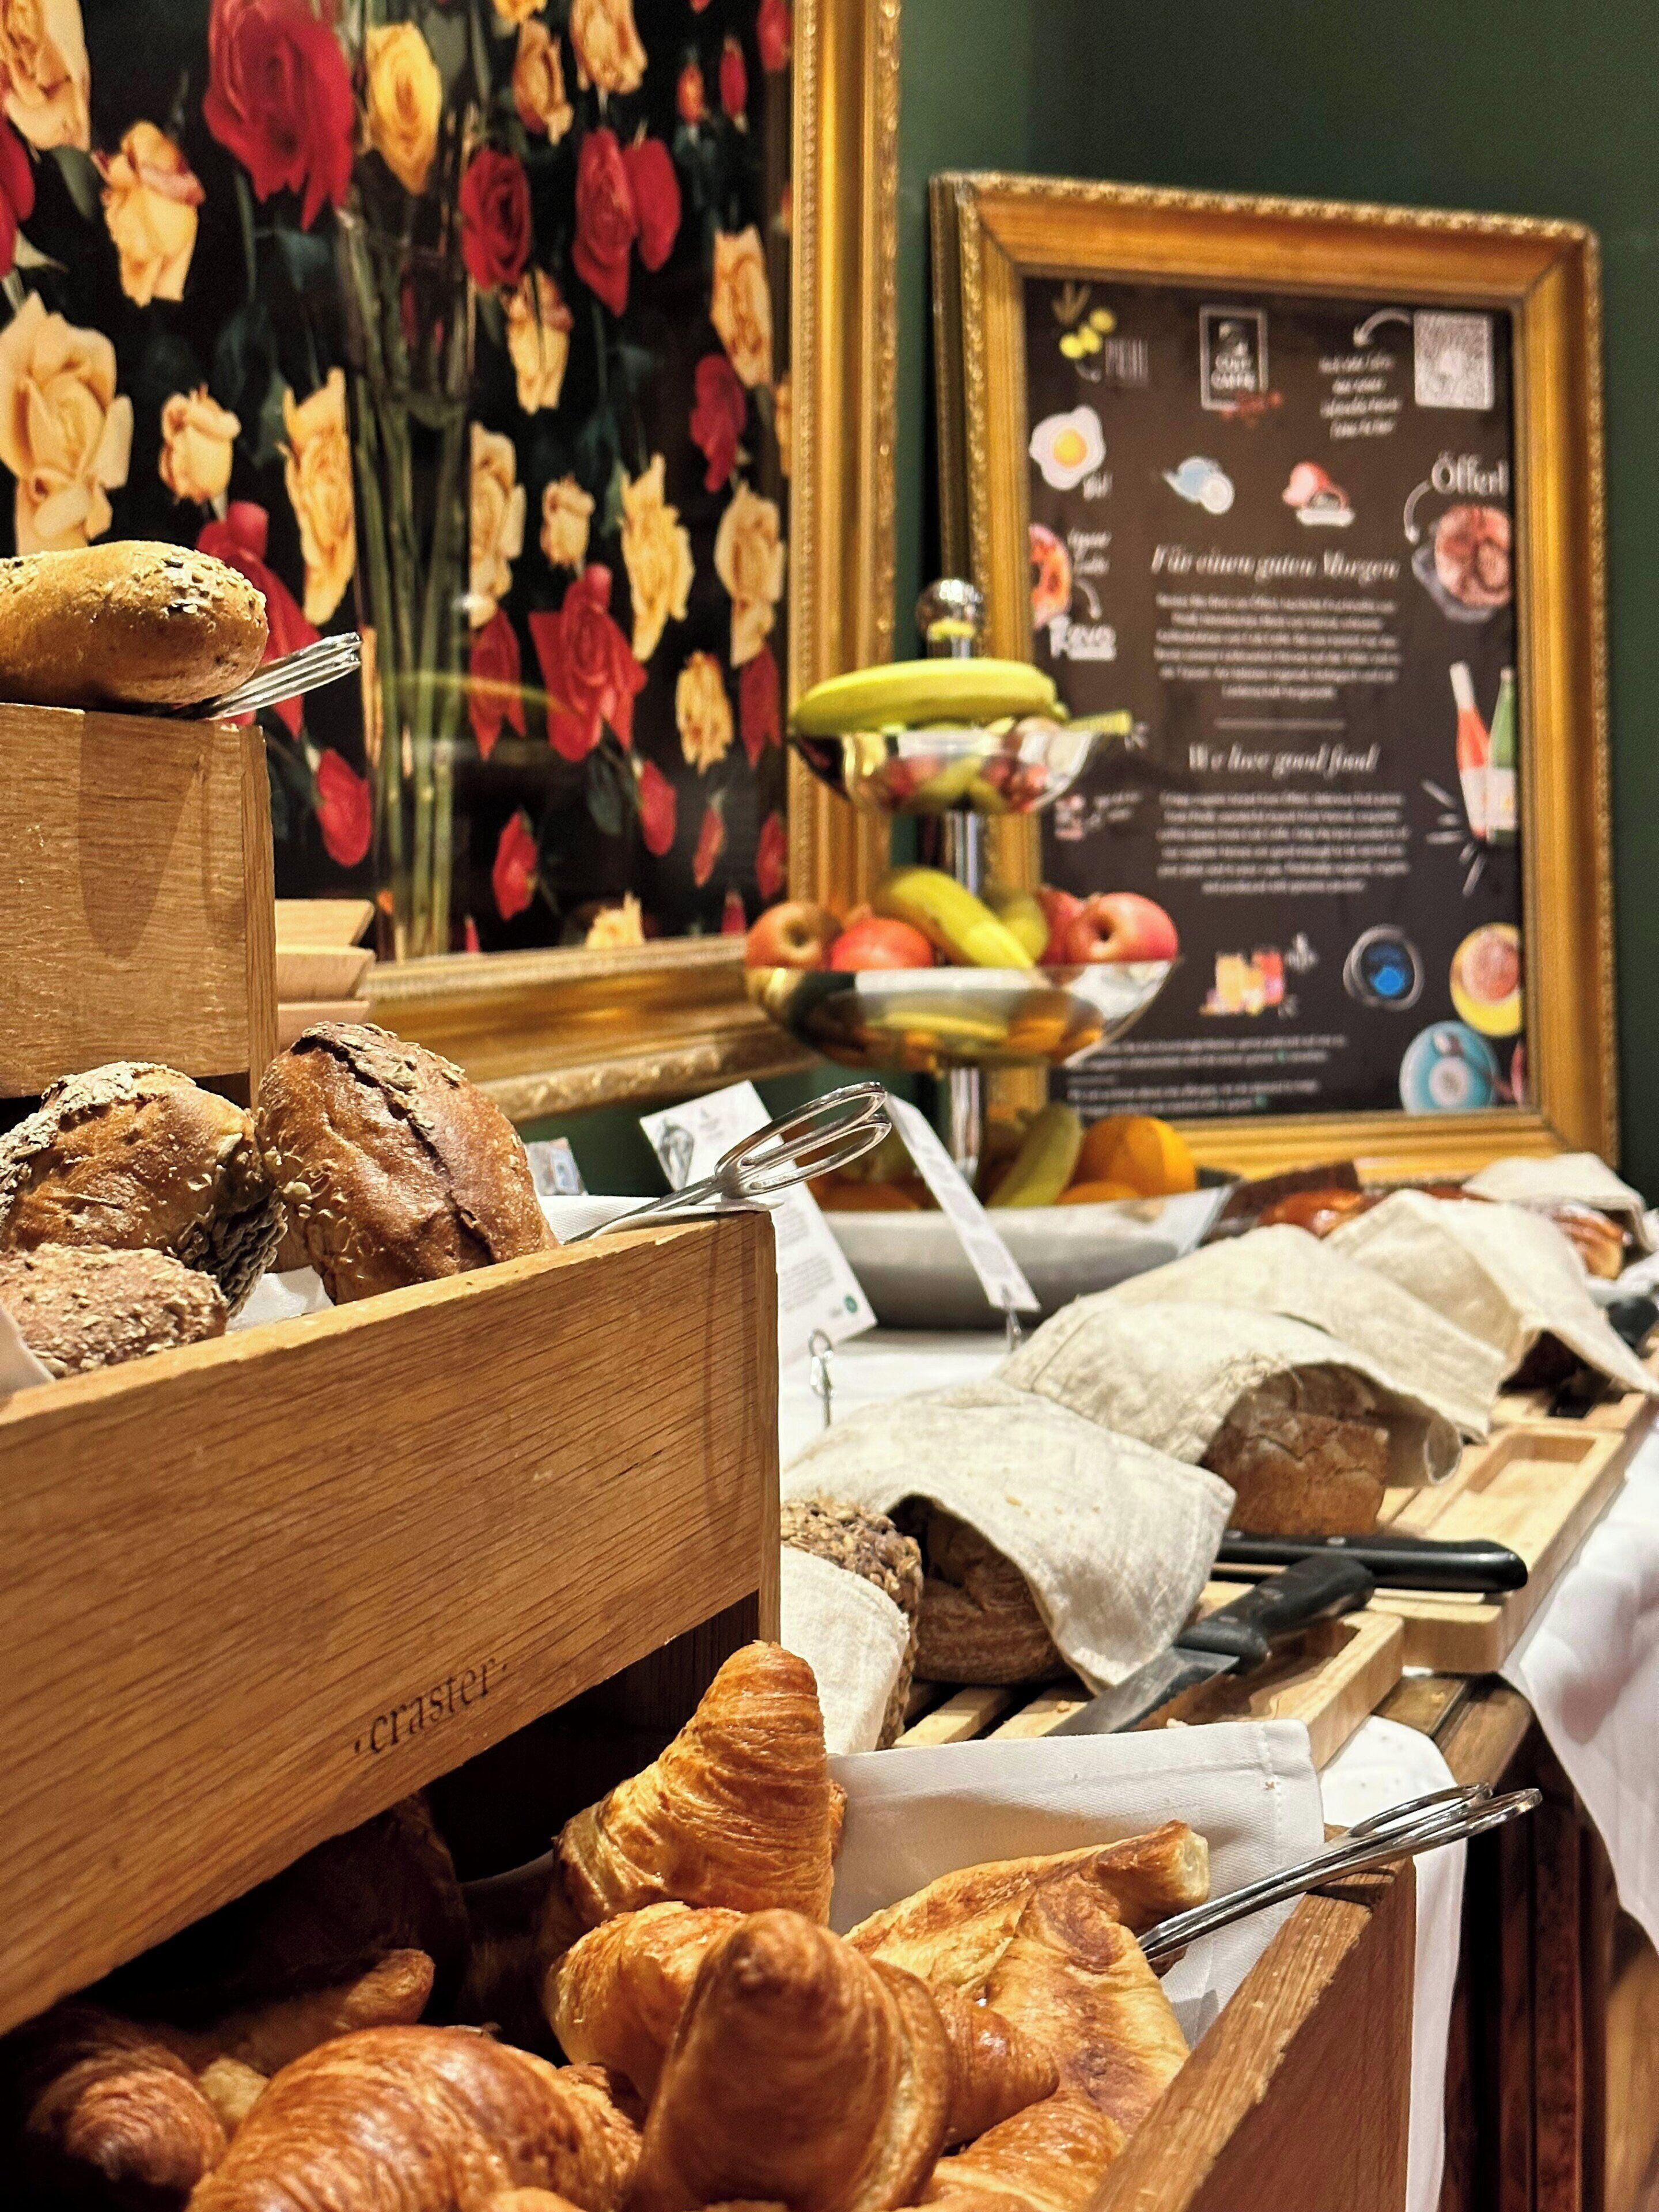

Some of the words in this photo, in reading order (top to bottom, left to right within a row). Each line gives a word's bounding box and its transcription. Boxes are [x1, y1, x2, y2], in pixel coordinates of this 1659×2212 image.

[1189, 744, 1225, 772] We
[1228, 741, 1271, 773] love
[1271, 743, 1330, 781] good
[1323, 743, 1381, 781] food
